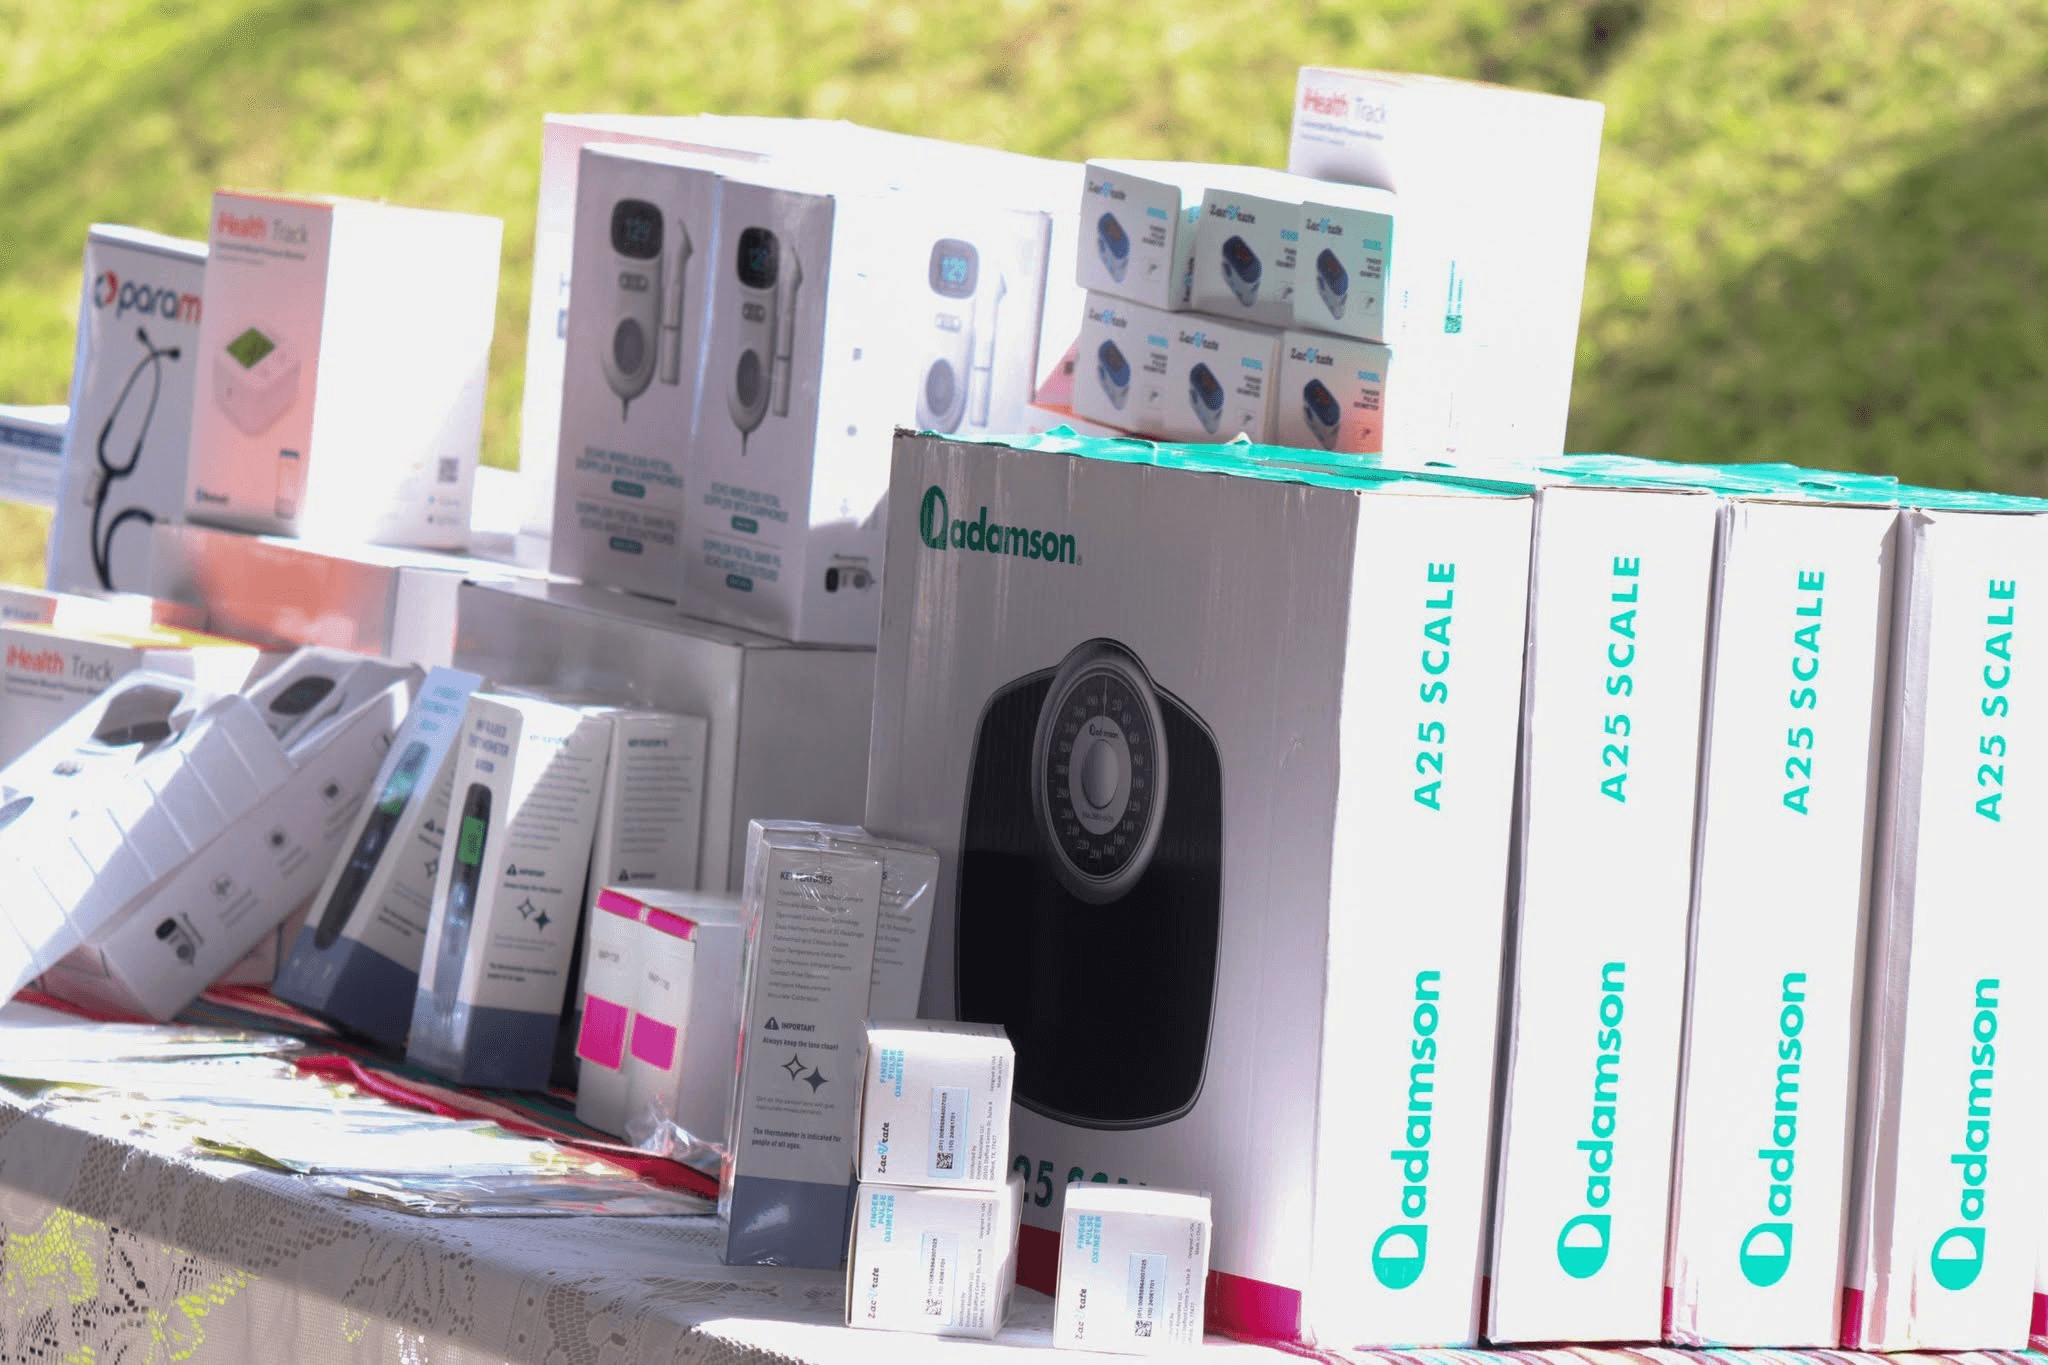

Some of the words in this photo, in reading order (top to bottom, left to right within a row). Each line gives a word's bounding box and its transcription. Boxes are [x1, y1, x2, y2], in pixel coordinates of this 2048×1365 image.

[116, 280, 202, 325] param
[951, 506, 1076, 564] adamson
[7, 642, 65, 676] iHealth
[72, 653, 113, 682] Track
[1420, 563, 1455, 704] SCALE
[1606, 557, 1640, 697] SCALE
[1790, 571, 1825, 710] SCALE
[1981, 580, 2016, 717] SCALE
[1414, 721, 1446, 811] A25
[1600, 714, 1631, 803] A25
[1783, 727, 1813, 815] A25
[1975, 735, 2007, 822] A25
[781, 1022, 816, 1032] IMPORTANT
[1391, 970, 1441, 1218] adamson
[1576, 962, 1626, 1208] adamson
[1758, 973, 1806, 1216] adamson
[1950, 979, 2000, 1221] adamson
[1013, 1154, 1054, 1208] 25
[1092, 1216, 1101, 1263] OXIMETER
